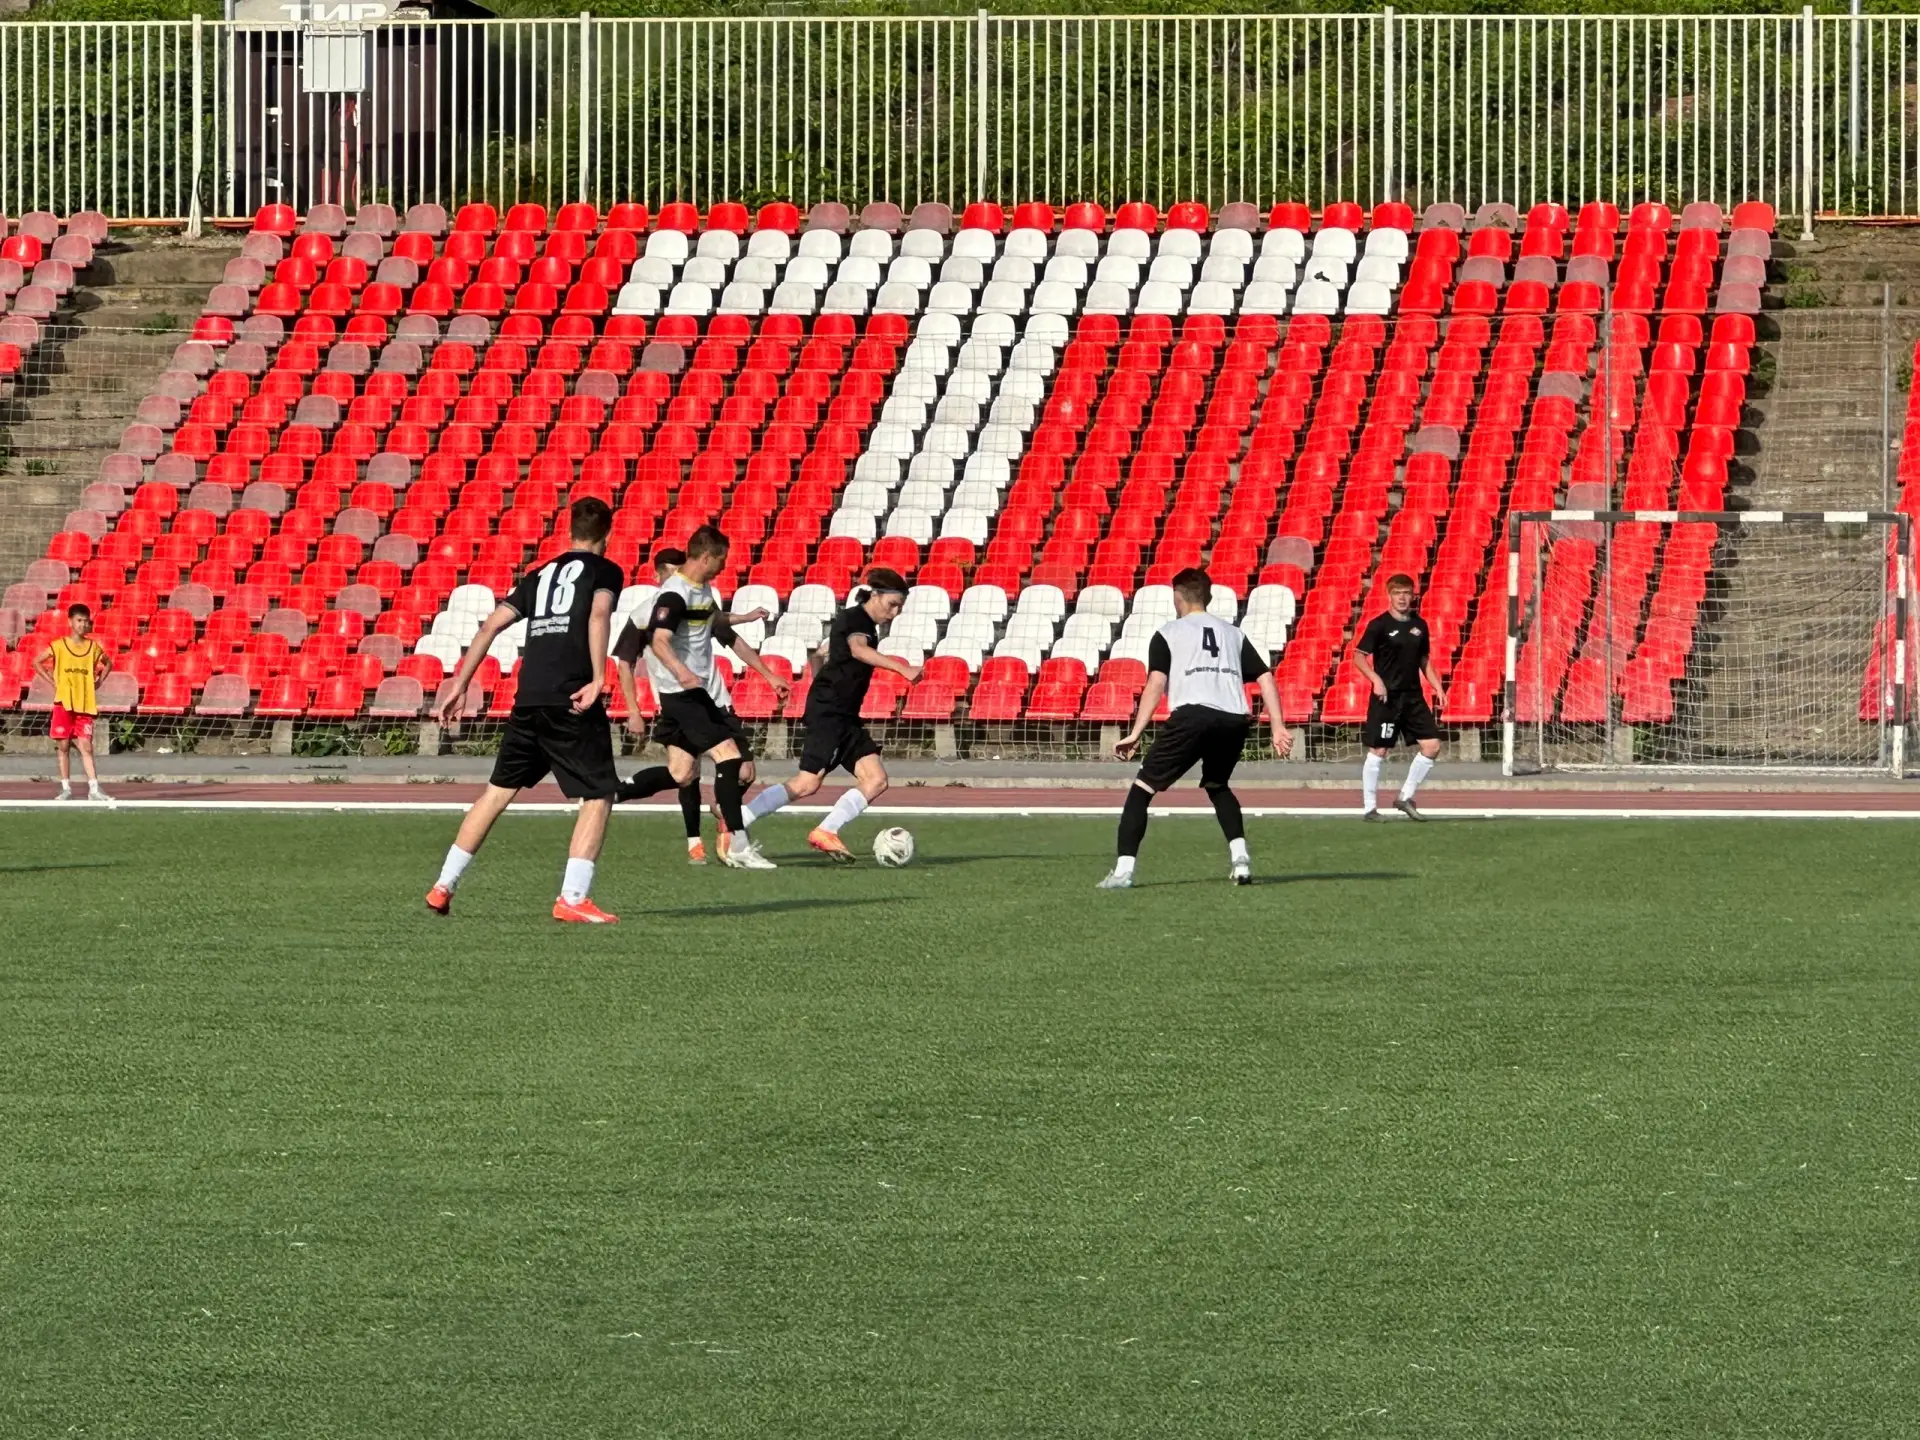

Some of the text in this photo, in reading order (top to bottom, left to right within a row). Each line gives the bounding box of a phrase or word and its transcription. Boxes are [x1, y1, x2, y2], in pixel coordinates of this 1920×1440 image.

[534, 559, 585, 617] 18
[1201, 626, 1220, 658] 4
[1380, 722, 1395, 739] 15
